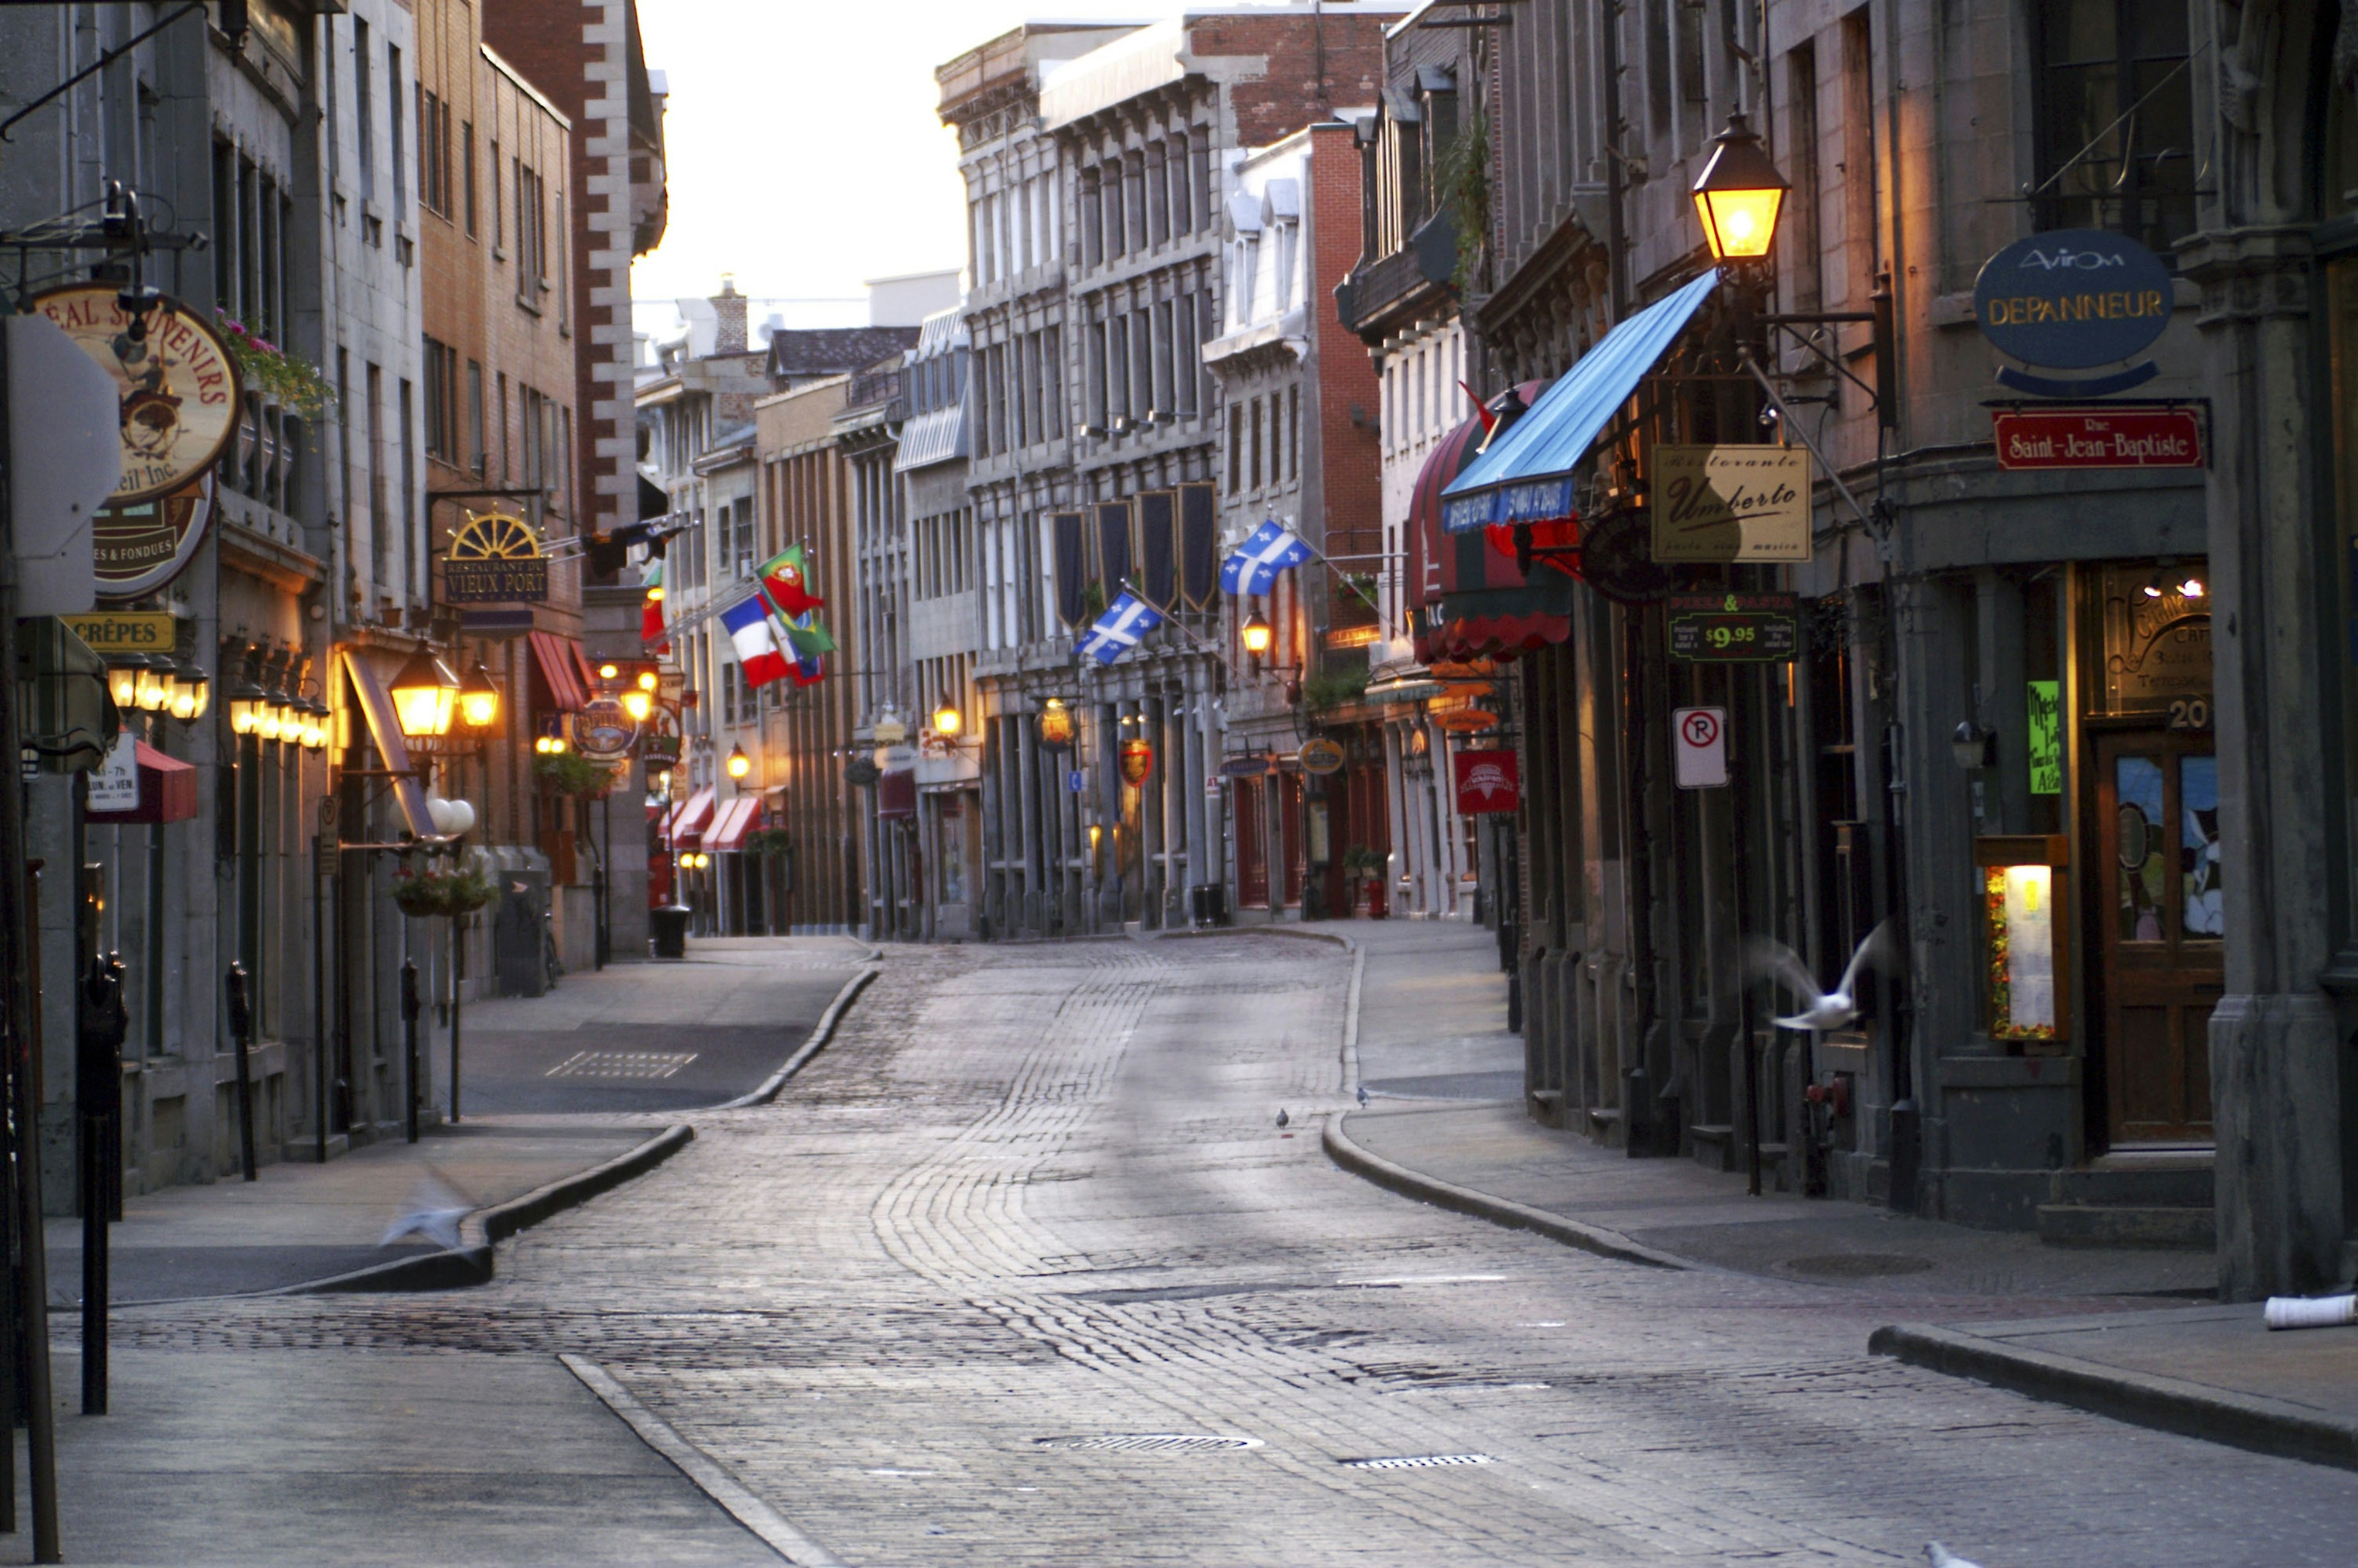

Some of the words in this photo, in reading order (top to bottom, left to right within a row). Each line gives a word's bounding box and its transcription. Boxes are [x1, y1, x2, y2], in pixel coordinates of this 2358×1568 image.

[1988, 290, 2164, 325] DEPANNEUR
[2085, 418, 2110, 431] Rue
[2009, 432, 2189, 464] Saint-Jean-Baptiste
[145, 461, 179, 485] Inc.
[1667, 476, 1796, 523] Umberto
[120, 539, 172, 560] FONDUES
[448, 562, 524, 572] RESTAURANT
[528, 561, 543, 571] DU
[448, 574, 499, 593] VIEUX
[505, 573, 545, 592] PORT
[72, 618, 157, 643] CRÊPES
[1705, 626, 1756, 649] $9.95
